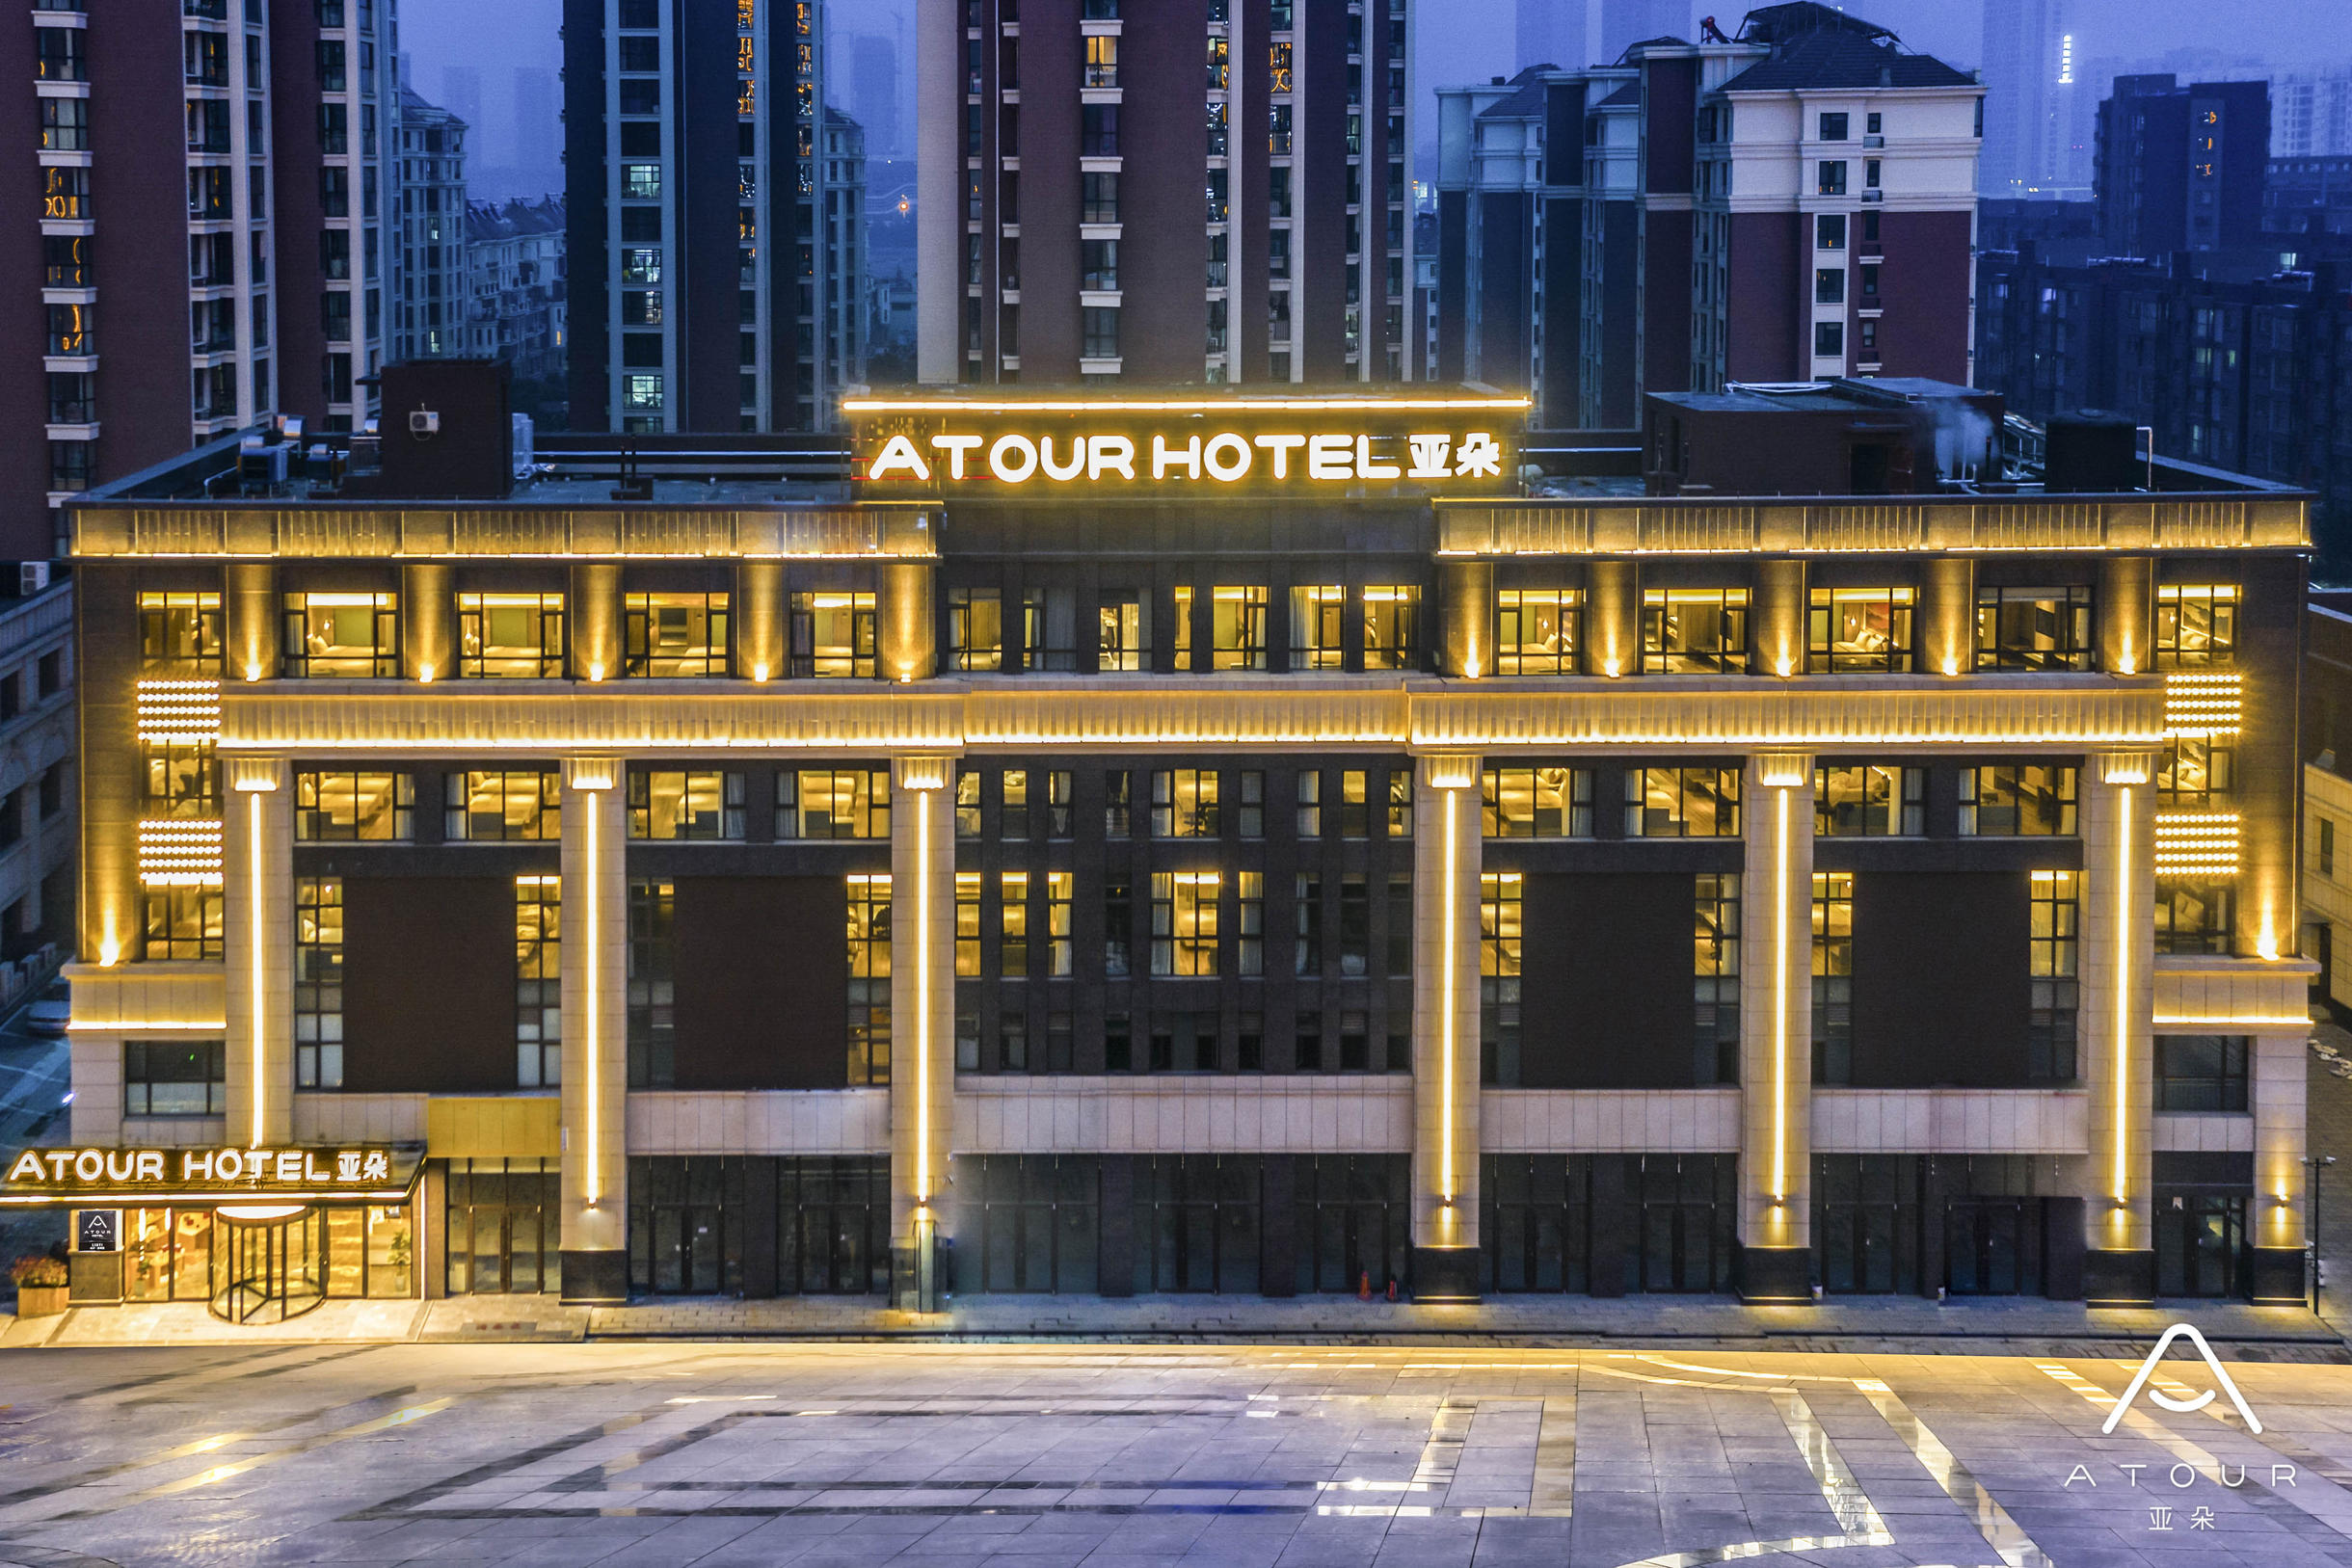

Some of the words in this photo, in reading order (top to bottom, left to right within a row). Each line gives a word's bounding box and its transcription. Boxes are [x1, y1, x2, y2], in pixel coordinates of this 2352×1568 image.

[869, 434, 1136, 483] ATOUR
[1152, 433, 1402, 482] HOTEL
[1407, 432, 1501, 479] 亚朵
[10, 1150, 164, 1182] ATOUR
[184, 1150, 331, 1182] HOTEL
[336, 1152, 388, 1182] 亚朵
